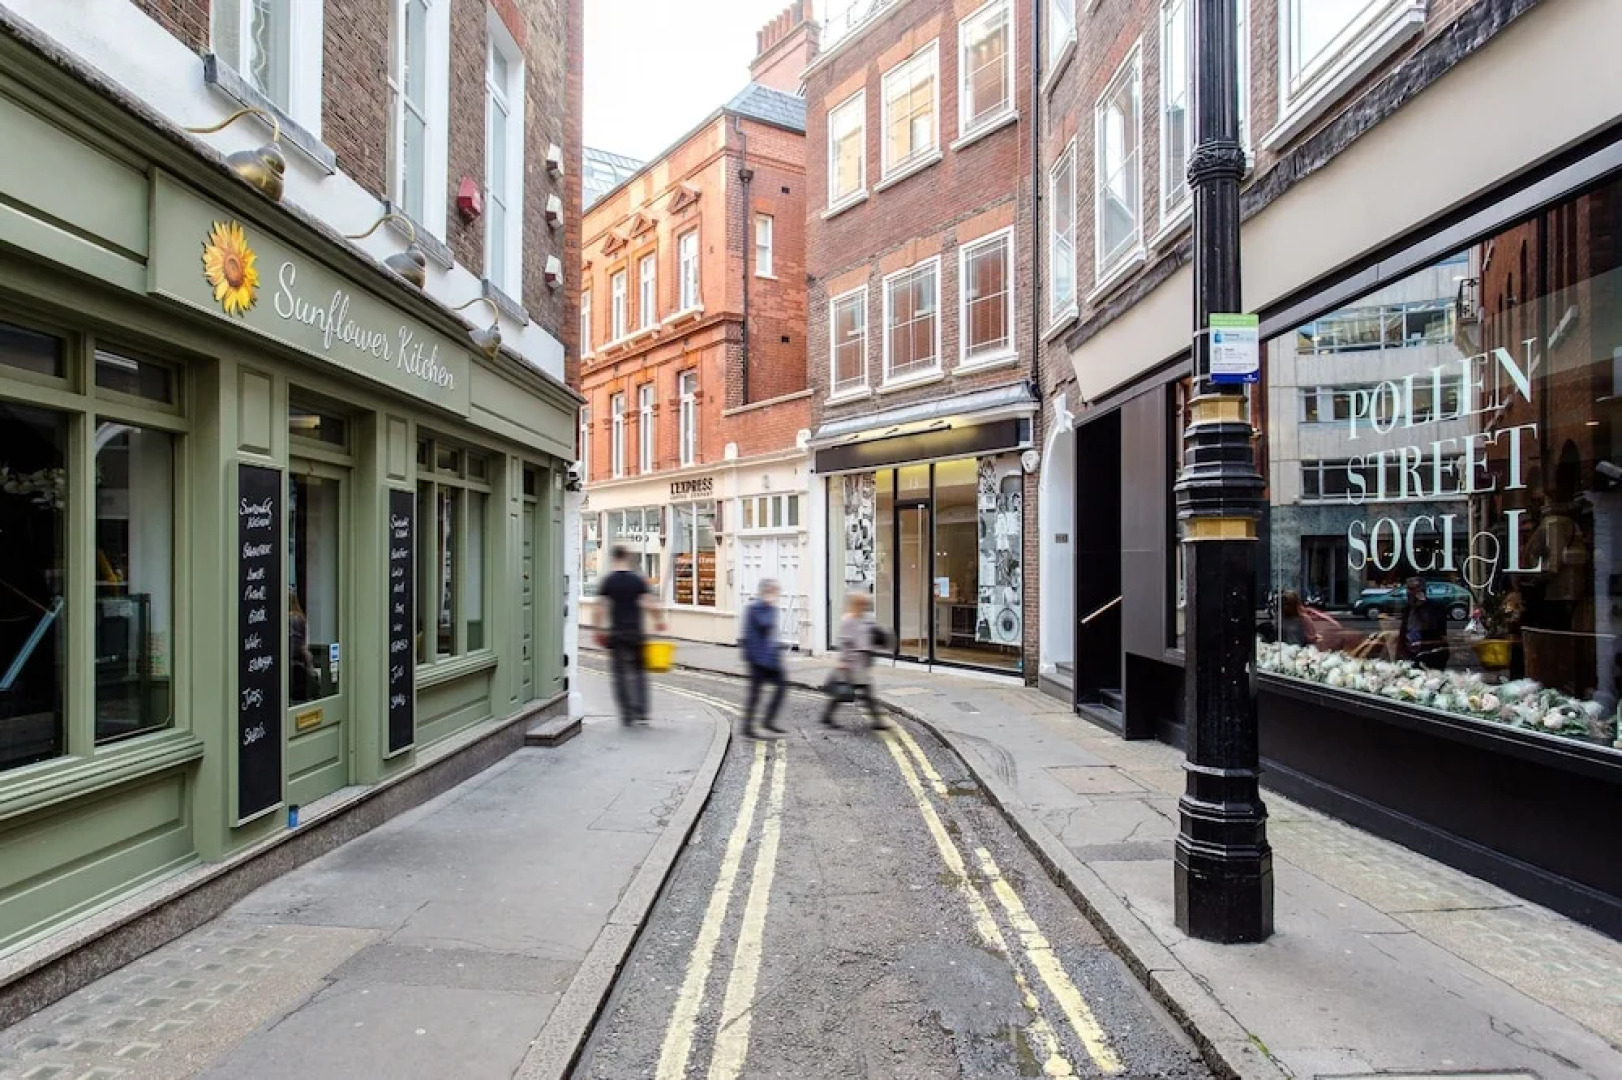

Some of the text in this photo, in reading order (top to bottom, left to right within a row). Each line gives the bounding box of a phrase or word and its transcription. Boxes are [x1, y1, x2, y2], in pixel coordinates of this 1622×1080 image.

[274, 261, 455, 390] Sunflower Kitchen
[1347, 337, 1538, 441] POLLEN
[1346, 422, 1538, 505] STREET
[1346, 508, 1543, 596] SOCIAL
